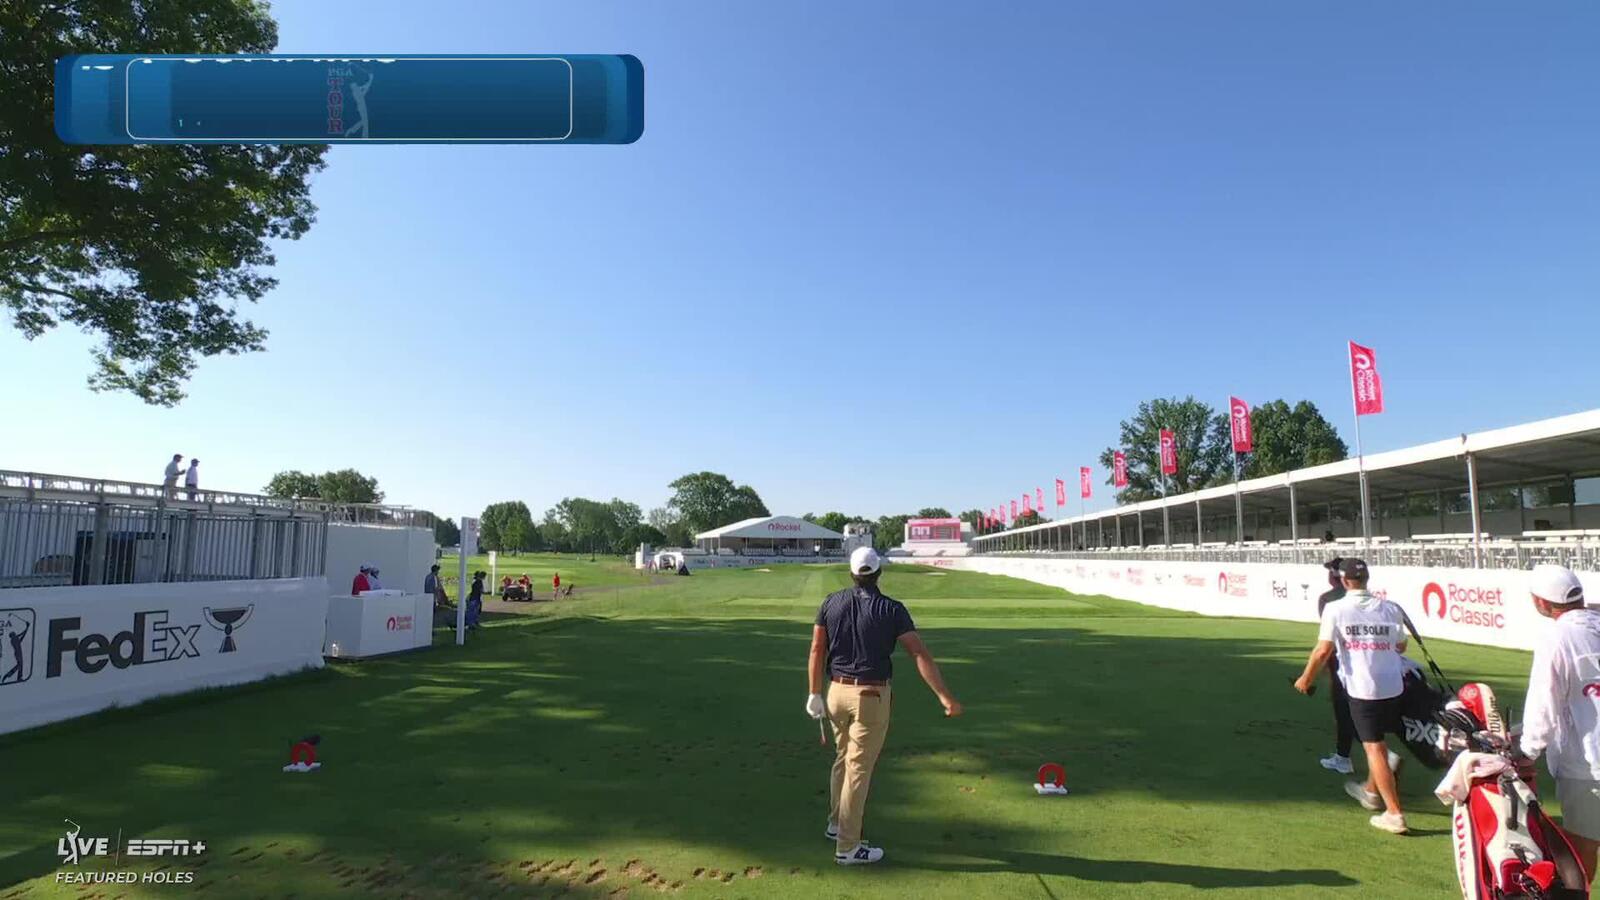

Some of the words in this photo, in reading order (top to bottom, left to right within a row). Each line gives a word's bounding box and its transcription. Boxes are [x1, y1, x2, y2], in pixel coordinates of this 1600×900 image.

[1447, 583, 1504, 606] Rocket
[1449, 604, 1505, 629] Classic
[1345, 625, 1362, 636] DEL
[46, 610, 202, 679] FedEx
